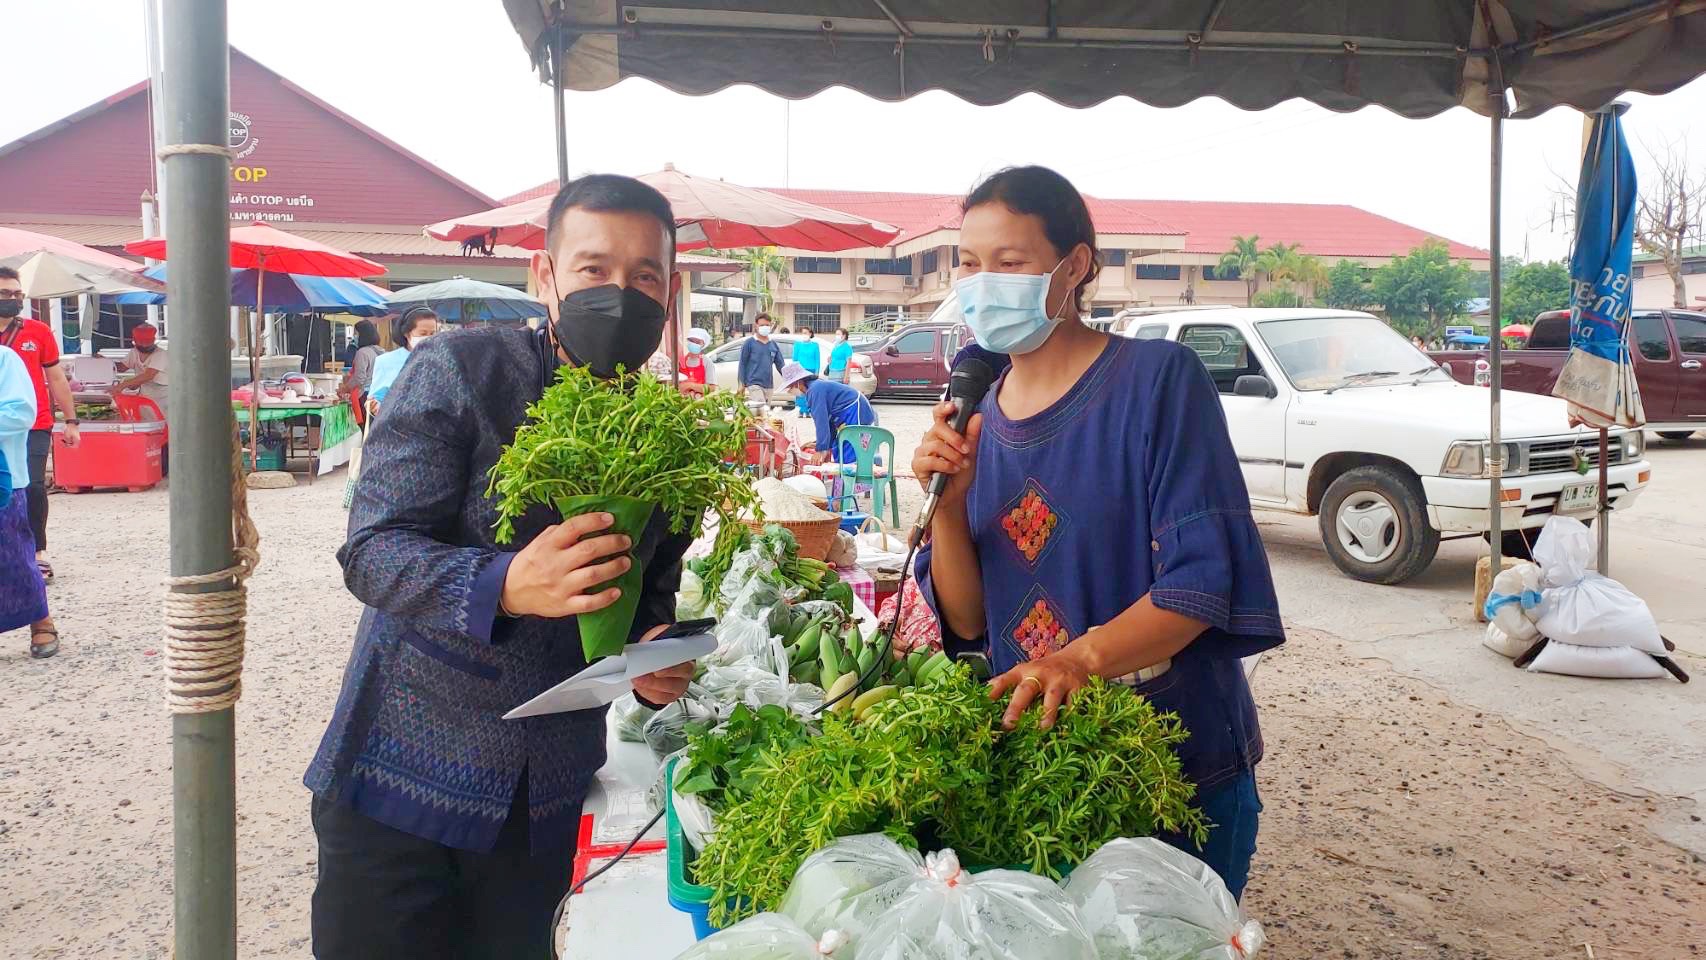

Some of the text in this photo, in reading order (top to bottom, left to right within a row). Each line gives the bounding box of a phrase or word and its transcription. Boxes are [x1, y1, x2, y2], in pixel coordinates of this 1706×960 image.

[229, 166, 268, 182] OP
[250, 195, 283, 205] OTOP
[229, 211, 294, 222] .มหาสารคาม
